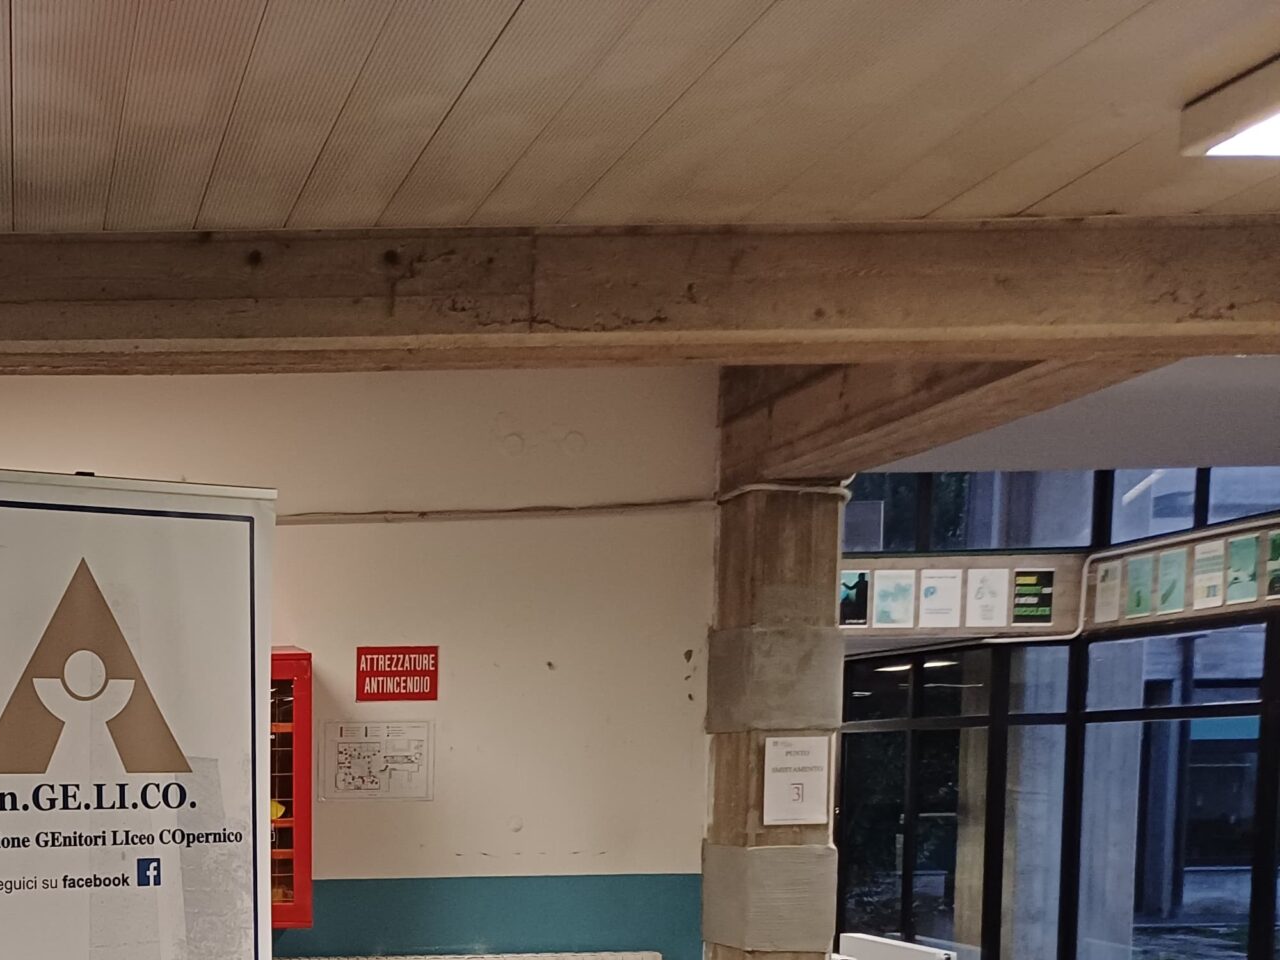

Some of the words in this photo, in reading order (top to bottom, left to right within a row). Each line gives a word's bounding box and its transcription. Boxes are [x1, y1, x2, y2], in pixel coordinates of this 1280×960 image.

[360, 654, 435, 671] ATTREZZATURE
[364, 676, 430, 693] ANTINCENDIO
[35, 830, 107, 848] GEnitori
[111, 829, 154, 846] LIceo
[159, 828, 243, 848] COpernico
[41, 878, 58, 889] su
[62, 873, 130, 889] facebook
